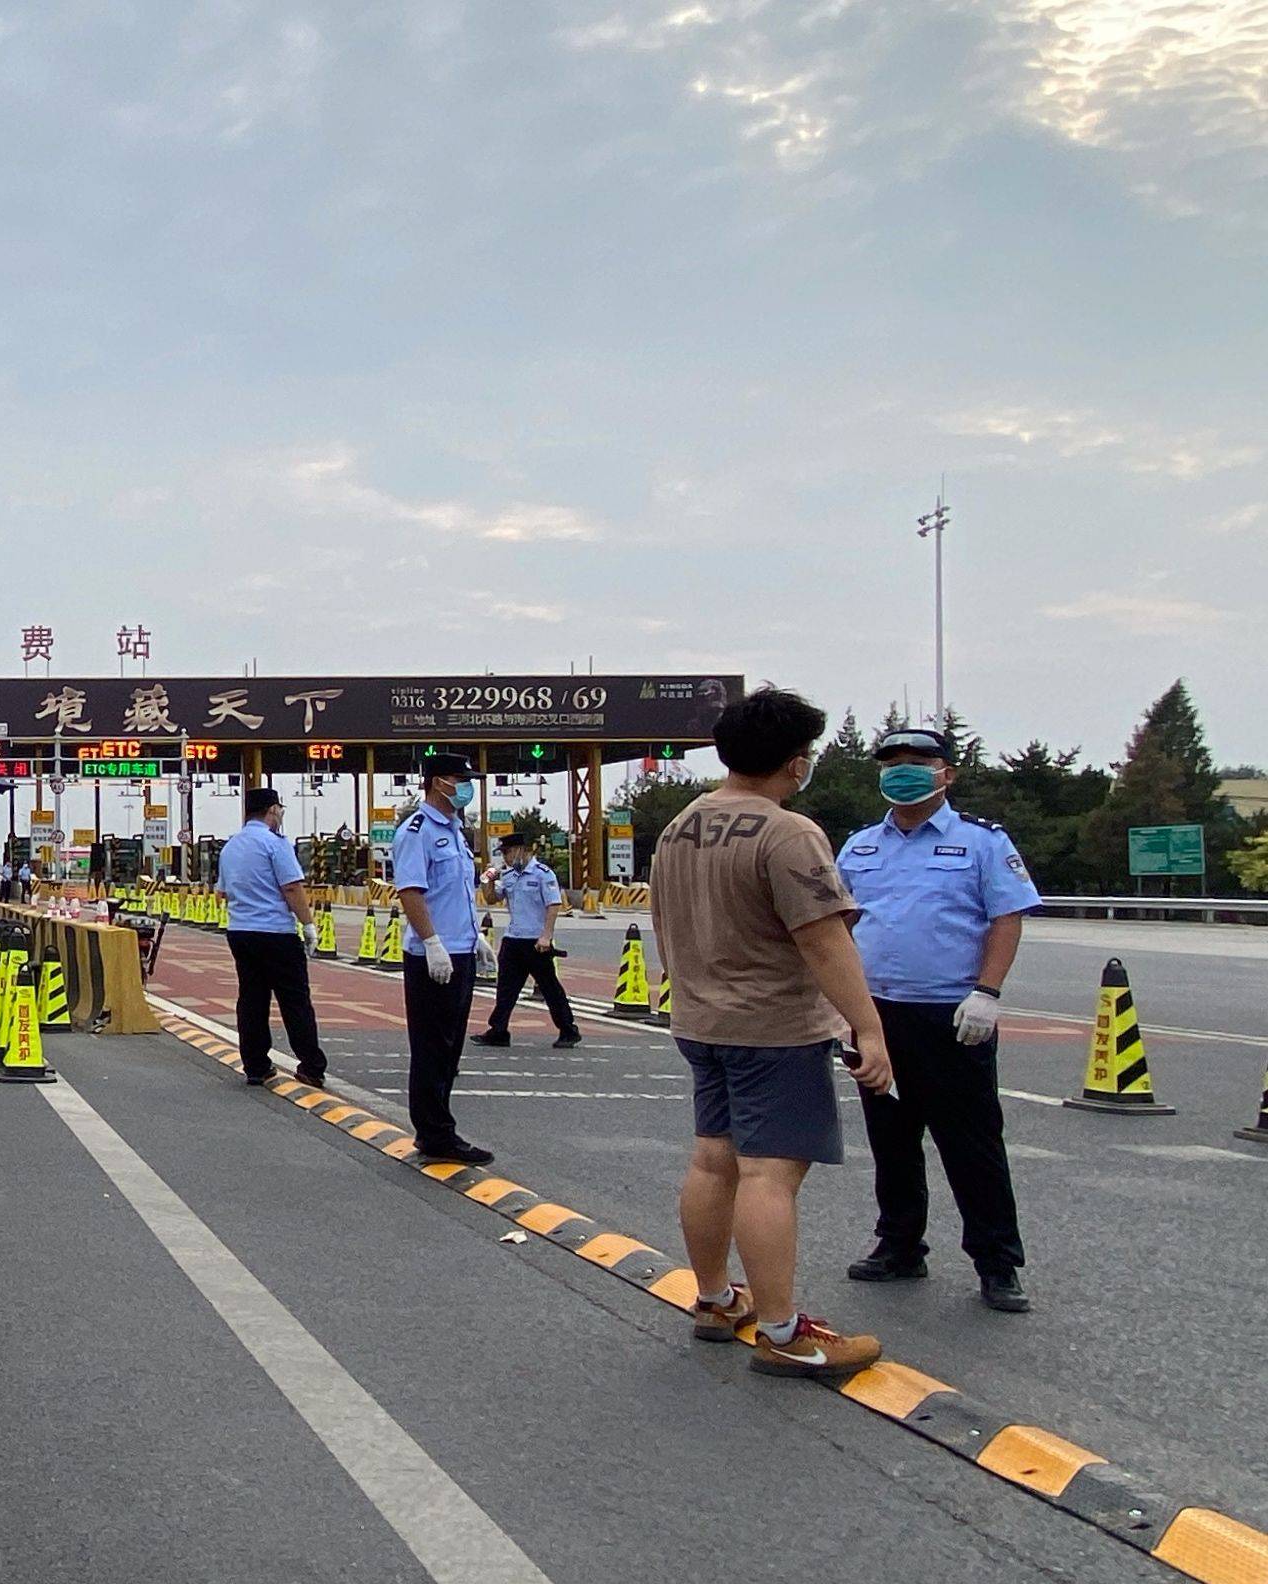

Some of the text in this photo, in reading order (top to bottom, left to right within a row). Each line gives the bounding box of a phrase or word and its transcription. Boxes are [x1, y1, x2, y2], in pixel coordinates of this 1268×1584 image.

[391, 695, 425, 708] 0316
[102, 741, 141, 757] ETC
[185, 744, 218, 759] ETC
[309, 744, 343, 759] ETC
